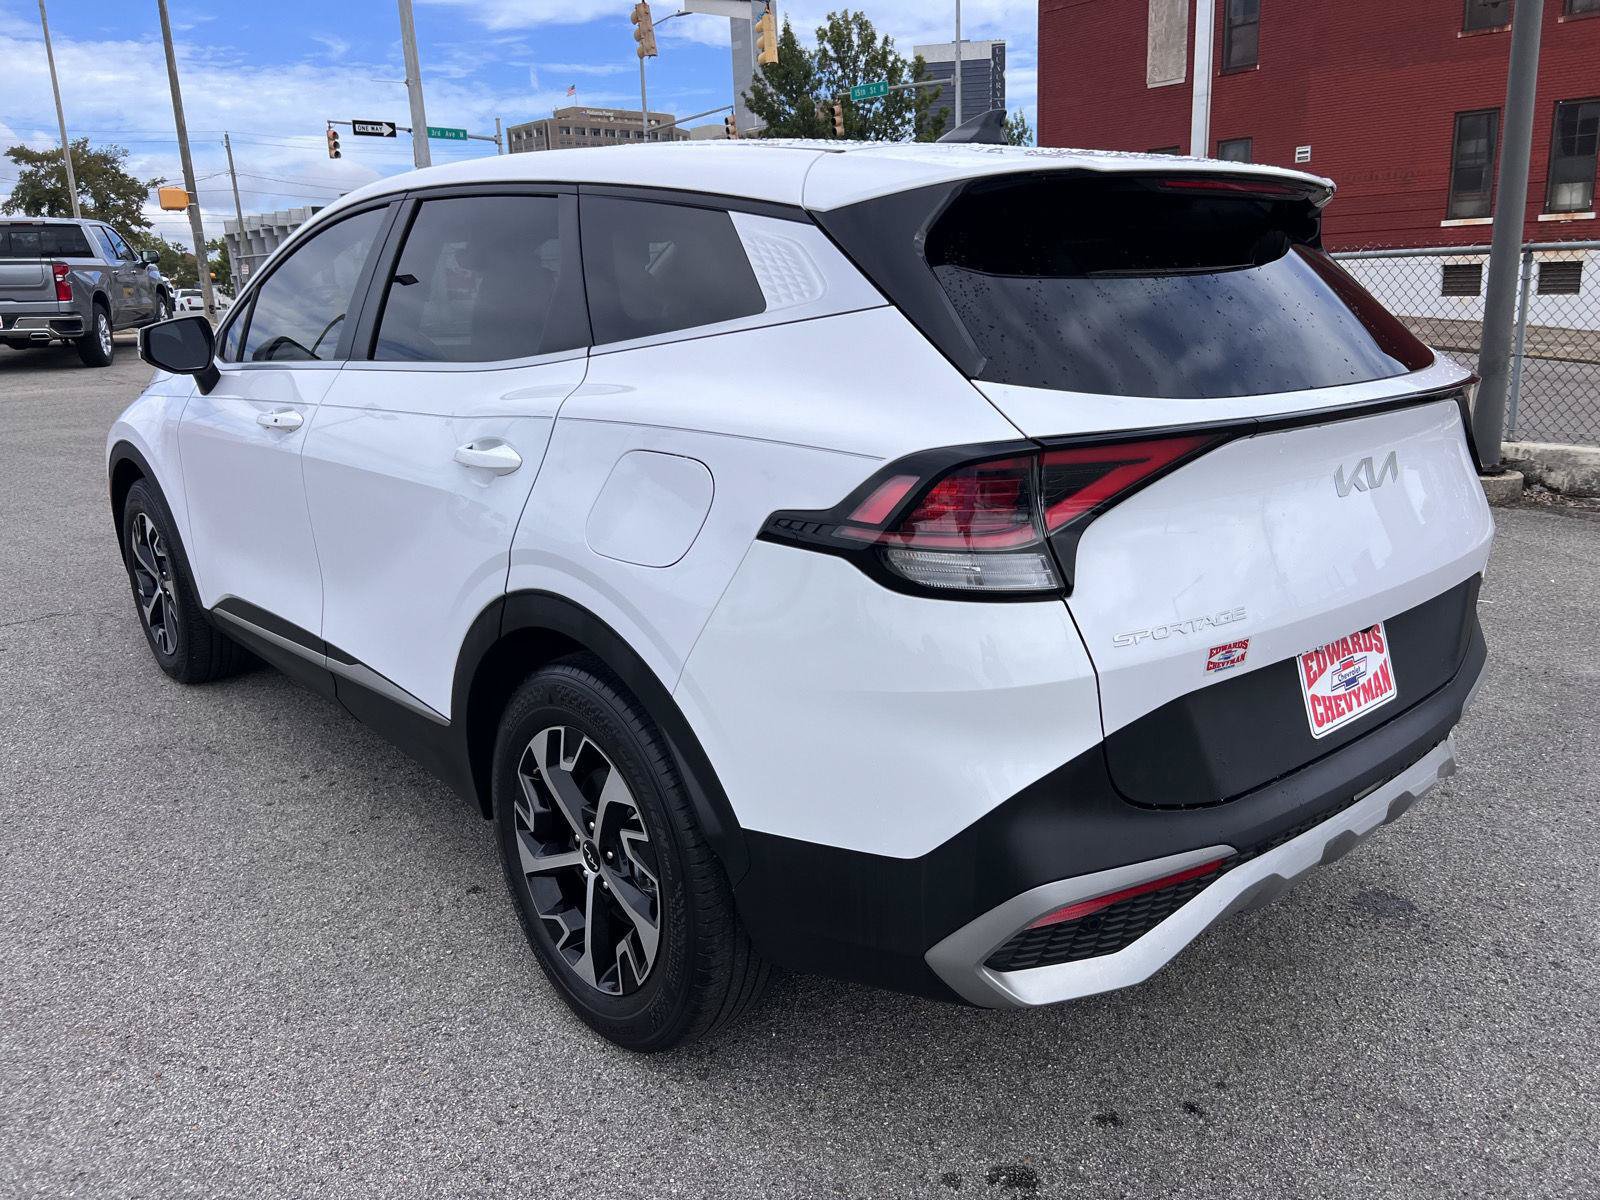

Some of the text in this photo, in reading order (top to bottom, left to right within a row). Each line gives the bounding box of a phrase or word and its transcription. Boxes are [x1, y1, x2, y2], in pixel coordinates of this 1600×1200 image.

[431, 128, 441, 136] 3rd
[444, 130, 455, 138] Ave
[1113, 606, 1247, 648] SPORTAGE
[1209, 639, 1250, 660] EDWARDS
[1302, 623, 1385, 692] EDWARDS
[1206, 650, 1247, 671] CHEVYMAN
[1337, 665, 1361, 682] Chevrolet
[1310, 658, 1392, 728] CHEVYMAN
